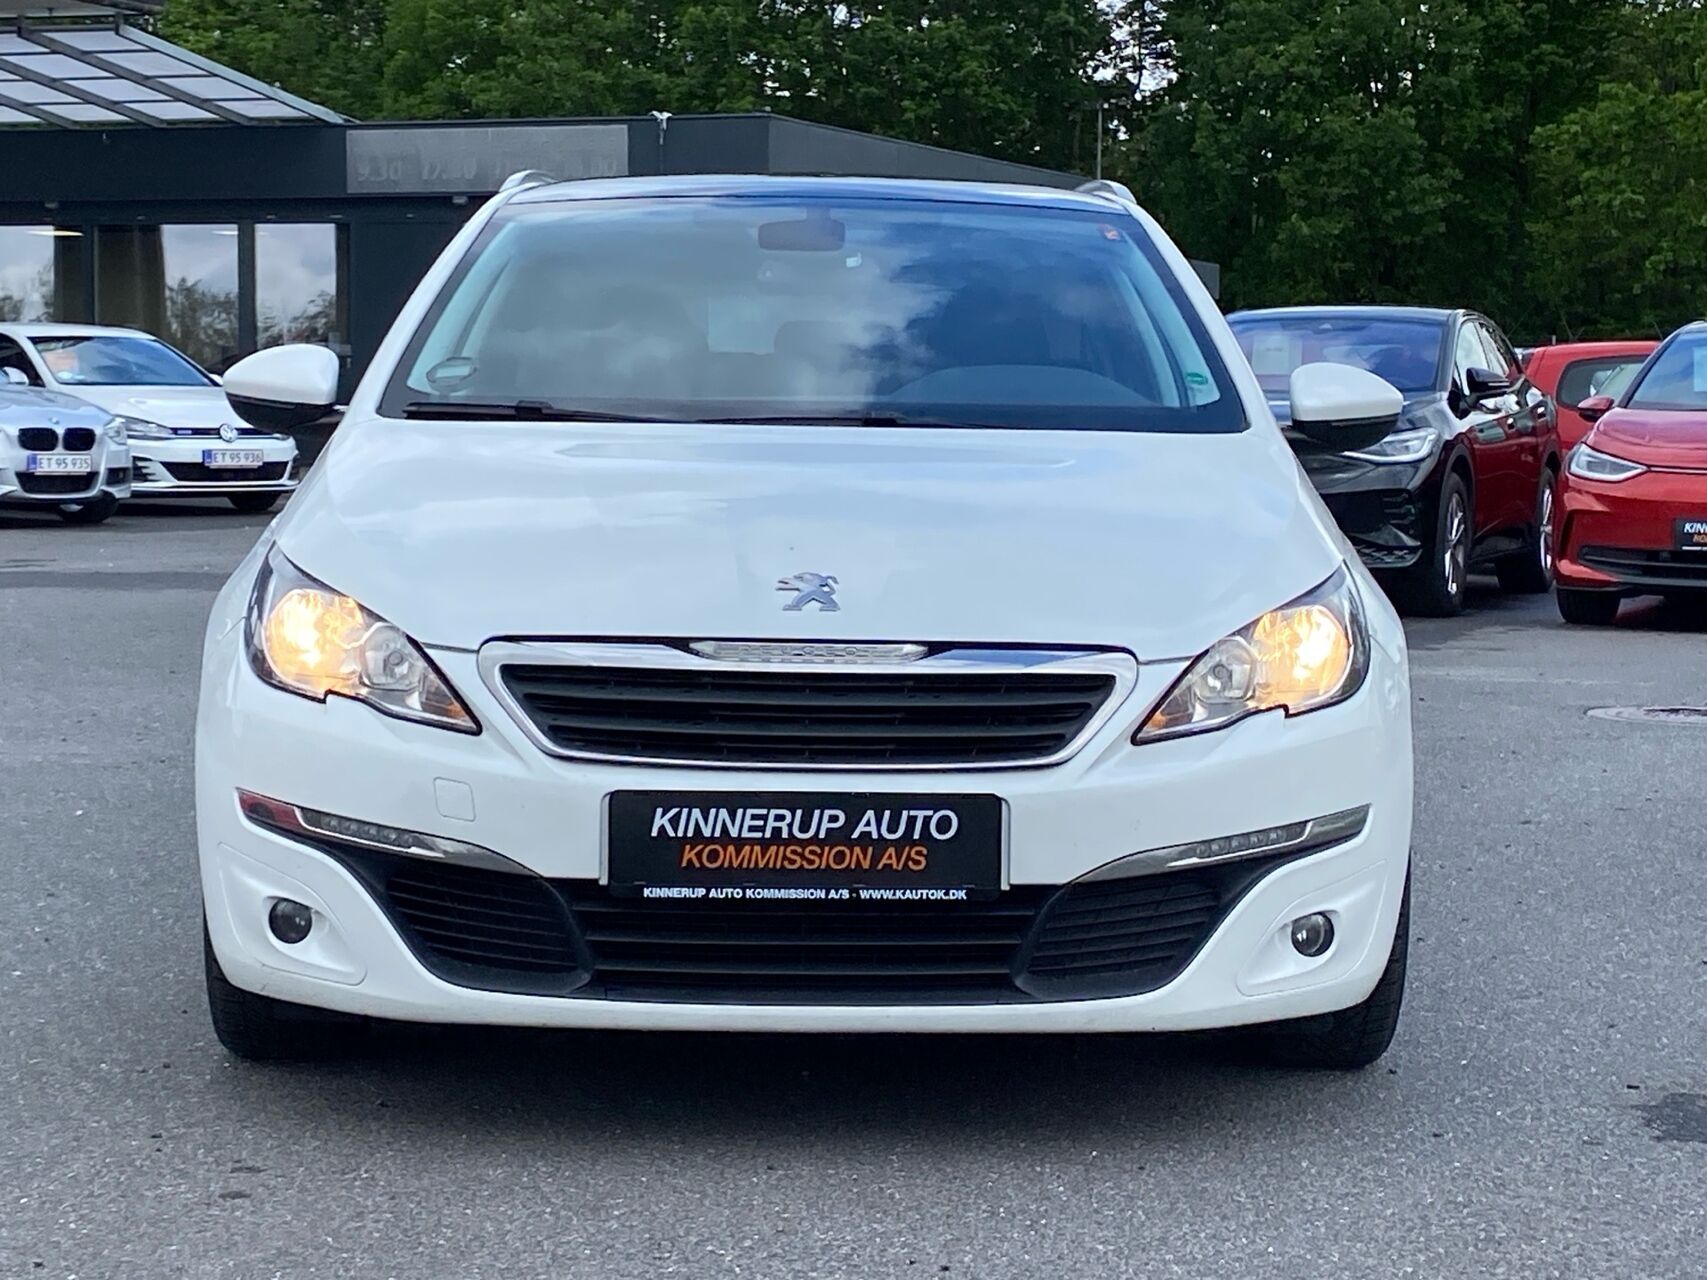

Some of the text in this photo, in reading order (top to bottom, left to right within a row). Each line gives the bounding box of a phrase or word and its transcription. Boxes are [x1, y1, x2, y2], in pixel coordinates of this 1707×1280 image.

[39, 457, 90, 469] ET 95 935
[212, 452, 226, 463] ET
[229, 452, 241, 463] 95
[1684, 522, 1707, 533] KIN
[651, 807, 958, 840] KINNERUP AUTO
[681, 844, 928, 871] KOMMISSION A/S
[643, 887, 706, 898] KINNERUP
[709, 888, 743, 899] AUTO
[745, 888, 825, 899] KOMMISSION
[828, 889, 850, 899] A/S
[859, 889, 967, 900] WWW.KAUTOK.DK
